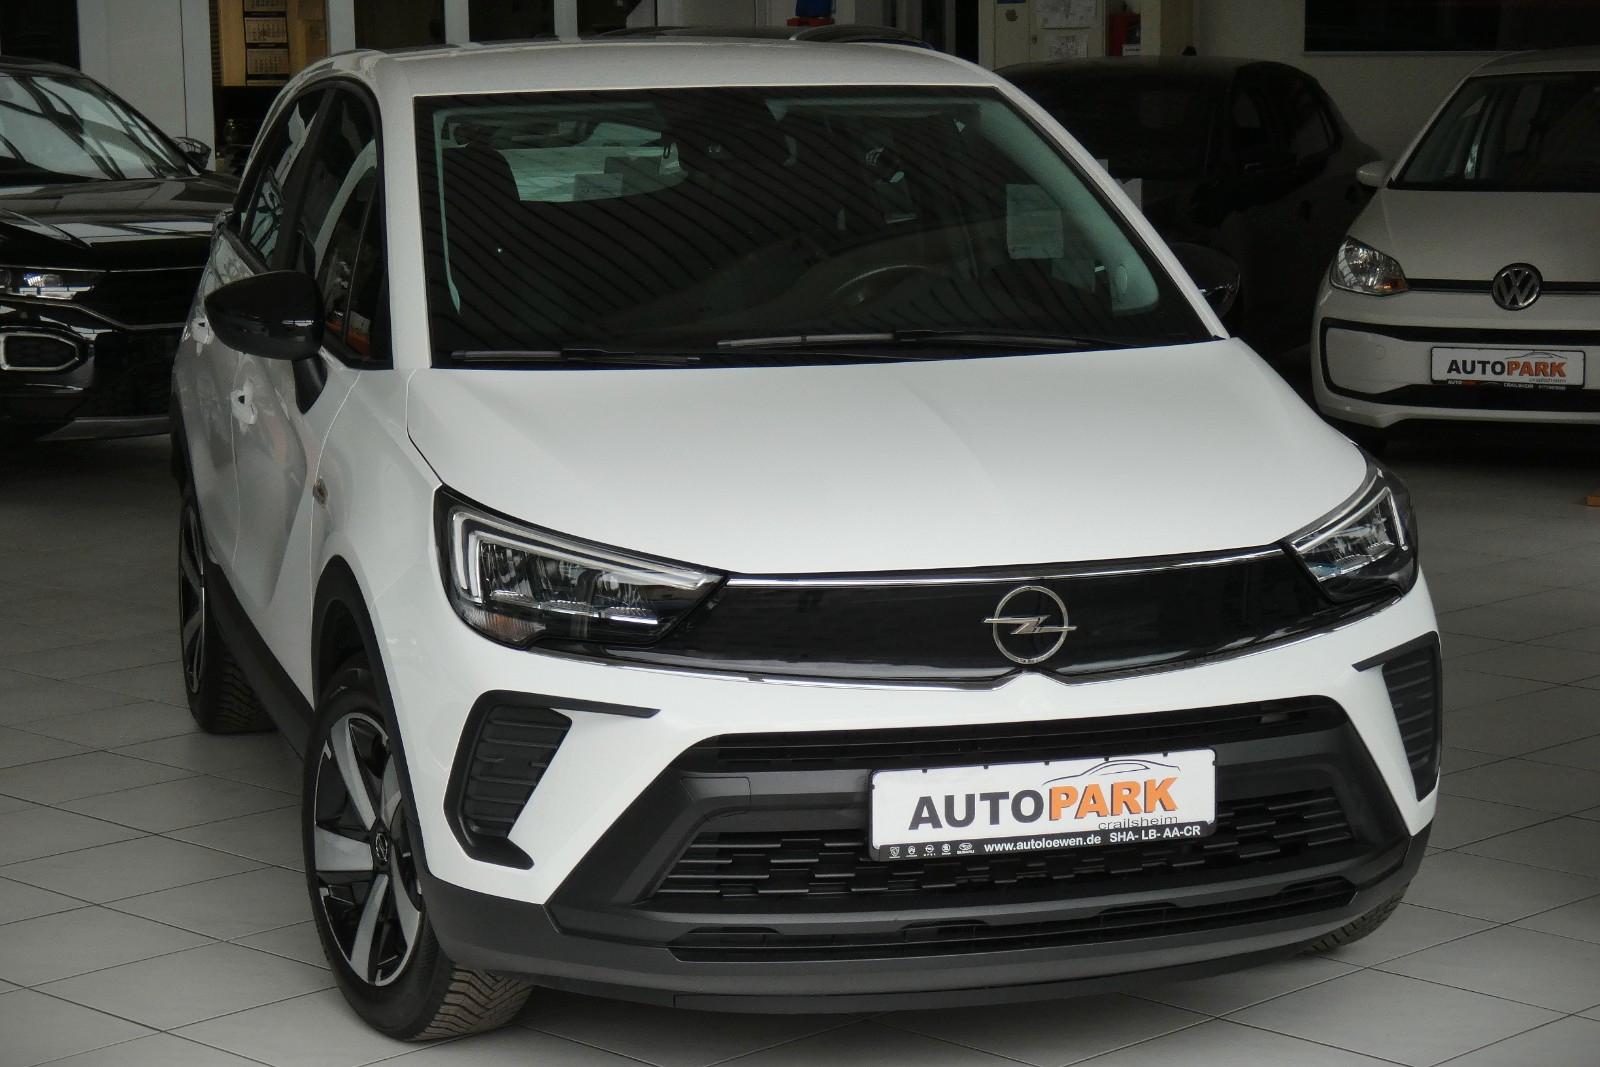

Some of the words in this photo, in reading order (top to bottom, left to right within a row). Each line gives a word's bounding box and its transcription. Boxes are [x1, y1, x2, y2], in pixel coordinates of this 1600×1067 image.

[1446, 359, 1567, 378] AUTOPARK
[908, 776, 1179, 831] AUTOPARK
[1098, 815, 1179, 831] crailsheim
[983, 834, 1101, 853] www.autoloewen.de
